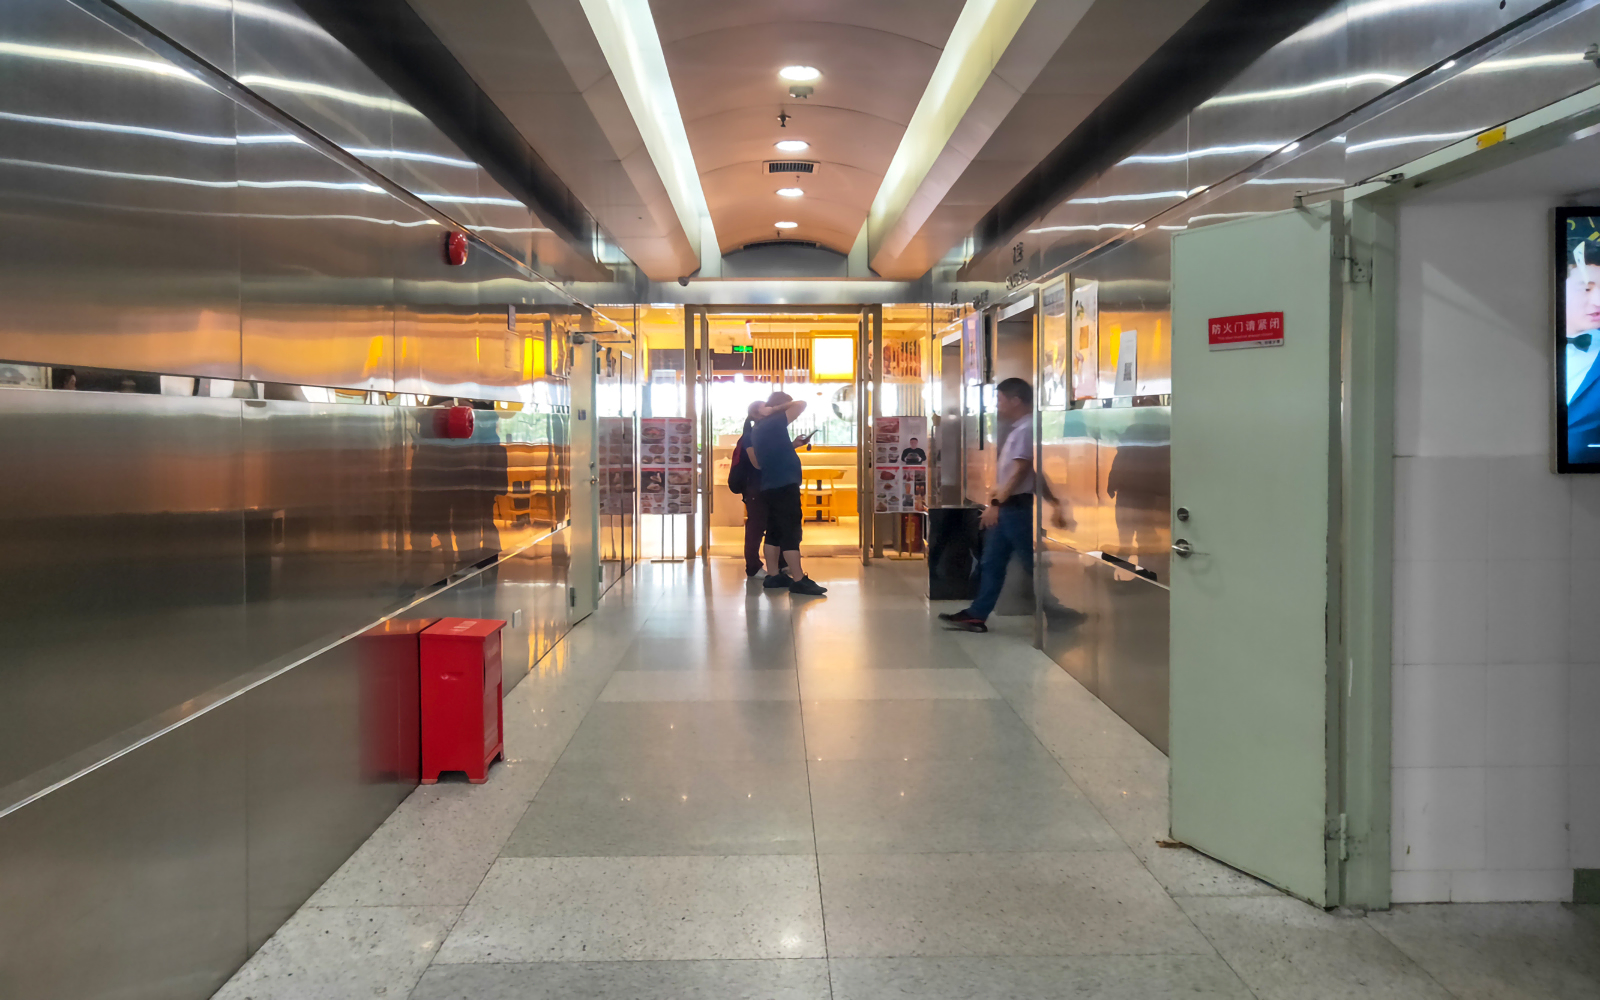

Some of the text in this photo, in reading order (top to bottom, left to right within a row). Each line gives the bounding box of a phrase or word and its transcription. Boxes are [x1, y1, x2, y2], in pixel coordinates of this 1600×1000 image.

[1211, 317, 1280, 335] 防火门请紧闭
